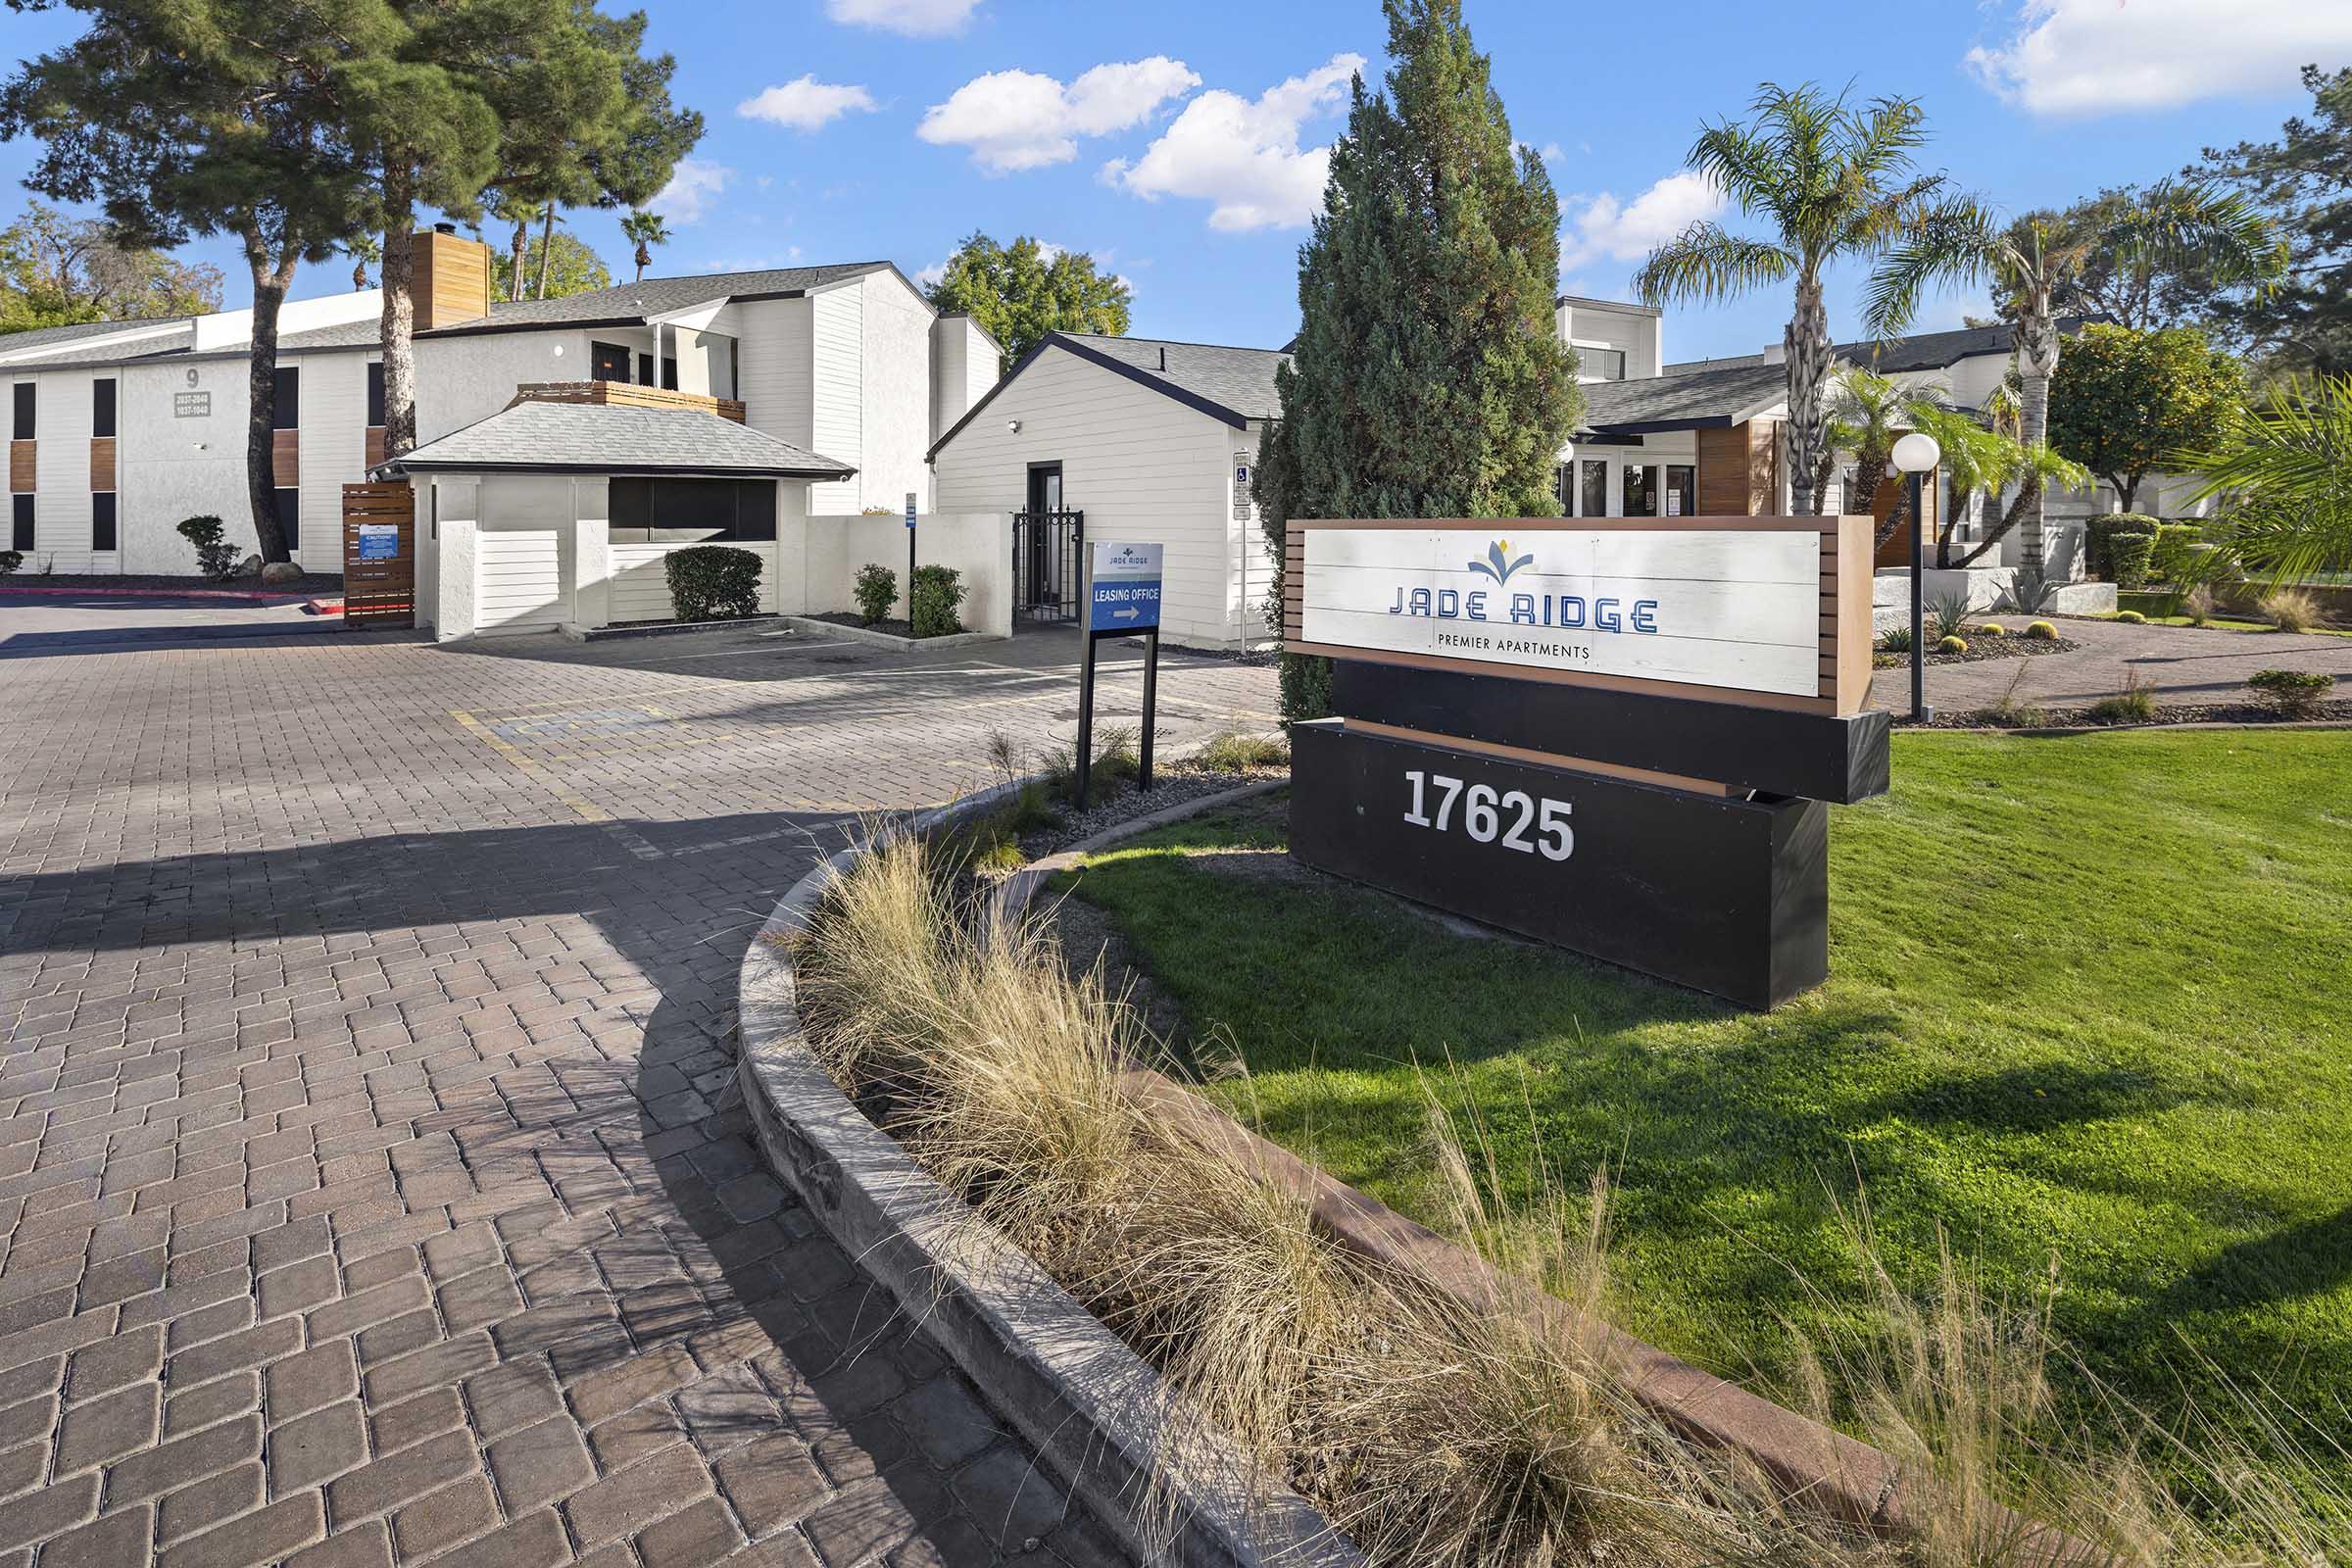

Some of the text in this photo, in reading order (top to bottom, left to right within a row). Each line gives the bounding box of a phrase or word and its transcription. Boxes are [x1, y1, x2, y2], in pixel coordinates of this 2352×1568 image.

[187, 368, 199, 388] 9
[1095, 588, 1159, 603] LEASING OFFICE
[1390, 587, 1658, 634] JADE RIDGE
[1438, 633, 1590, 660] PREMIER APARTMENTS
[1403, 771, 1575, 861] 17625
